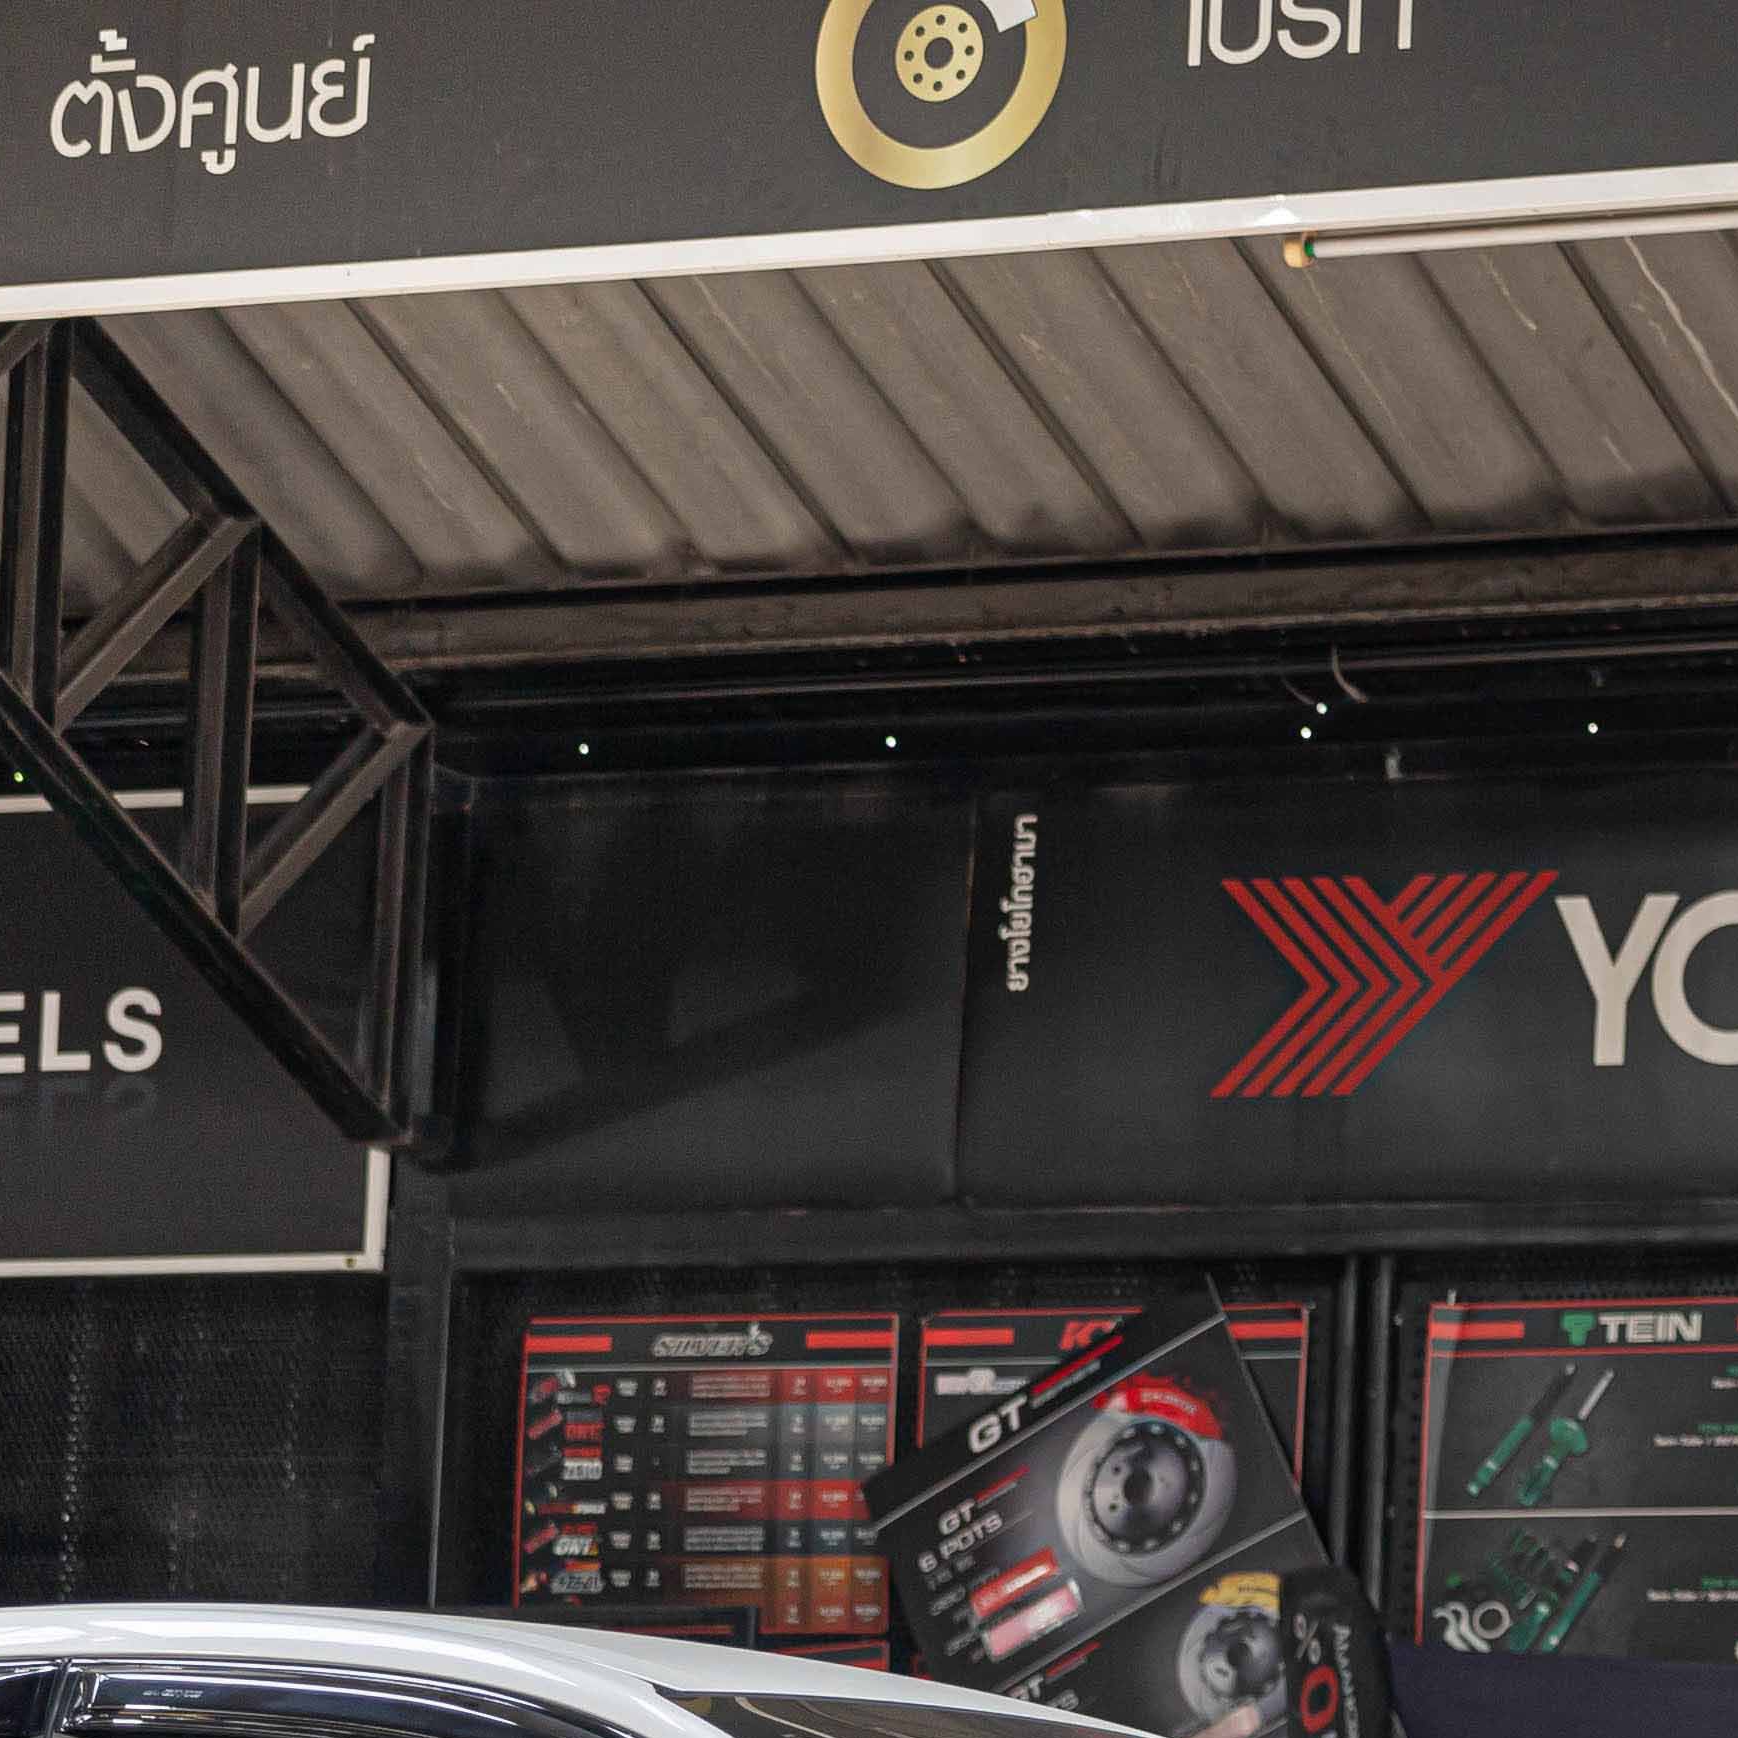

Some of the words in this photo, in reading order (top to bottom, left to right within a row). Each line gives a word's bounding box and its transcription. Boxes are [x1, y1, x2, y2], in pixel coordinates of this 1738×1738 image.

[50, 28, 376, 175] ตั้งศูนย์
[1000, 814, 1038, 991] ยางโยโกฮามา
[1597, 1311, 1703, 1344] TEIN
[968, 1394, 1028, 1454] GT
[938, 1499, 976, 1536] GT
